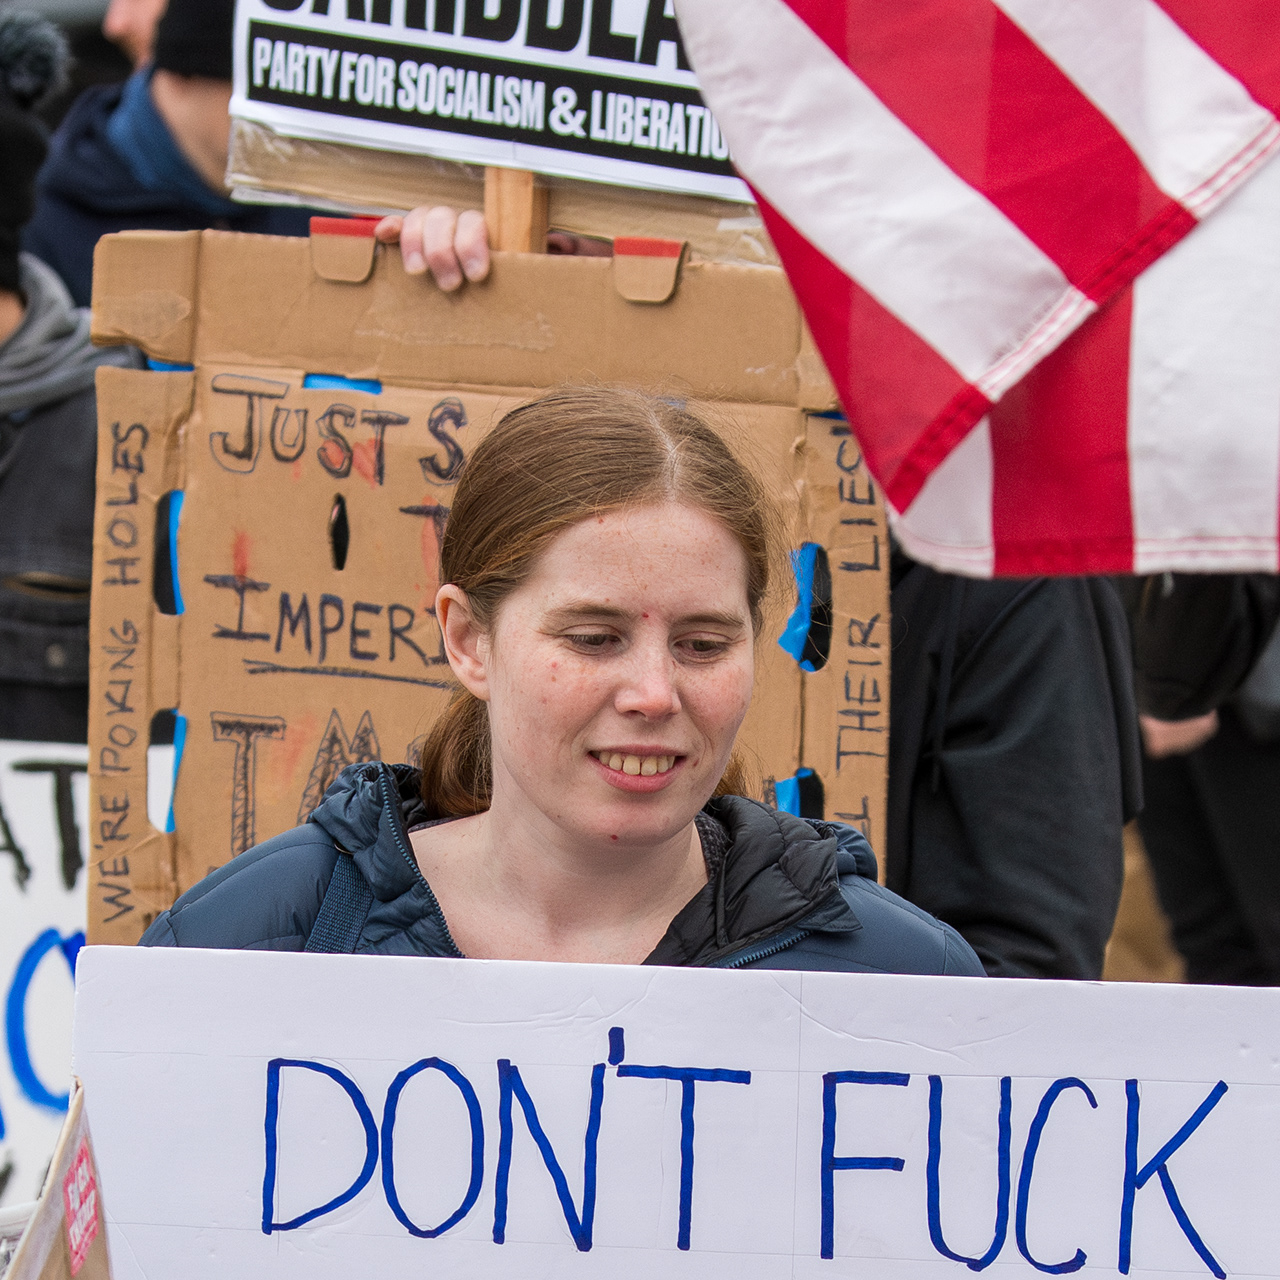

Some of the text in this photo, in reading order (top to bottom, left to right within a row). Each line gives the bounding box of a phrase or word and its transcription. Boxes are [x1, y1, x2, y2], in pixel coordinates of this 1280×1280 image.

[252, 37, 341, 101] PARTY
[340, 51, 398, 108] FOR
[399, 59, 545, 131] SOCIALISM
[549, 87, 588, 139] &
[209, 373, 410, 486] JUST
[95, 421, 151, 923] WE'RE POKING HOLES
[834, 612, 886, 777] THEIR
[261, 1026, 751, 1252] DON'T
[821, 1070, 1228, 1280] FUCK
